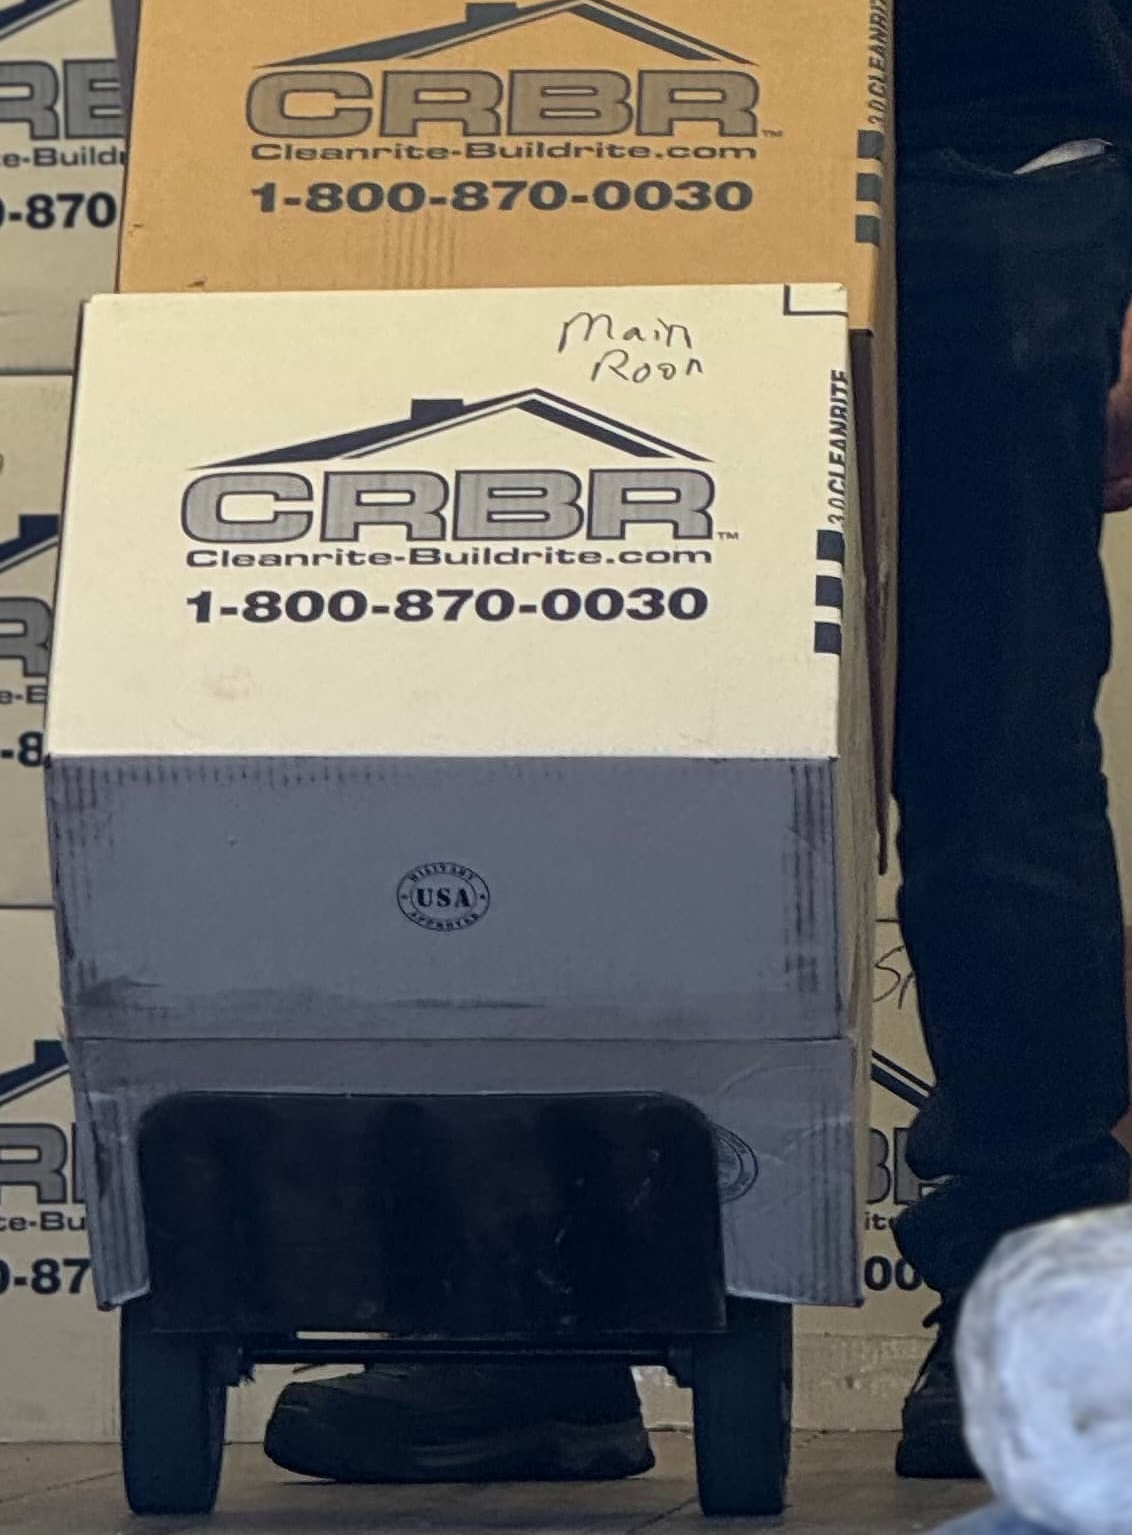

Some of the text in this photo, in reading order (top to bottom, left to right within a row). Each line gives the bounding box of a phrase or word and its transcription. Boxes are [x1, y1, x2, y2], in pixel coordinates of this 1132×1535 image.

[246, 68, 760, 138] CRBR
[250, 142, 758, 160] Cleanrite-Buildrite.com
[250, 180, 754, 214] 1-800-870-0030
[558, 311, 693, 354] Main
[181, 468, 717, 543] CRBR
[186, 548, 713, 568] Cleanrite-Buildrite.com
[186, 587, 709, 624] 1-800-870-0030
[416, 887, 471, 908] USA
